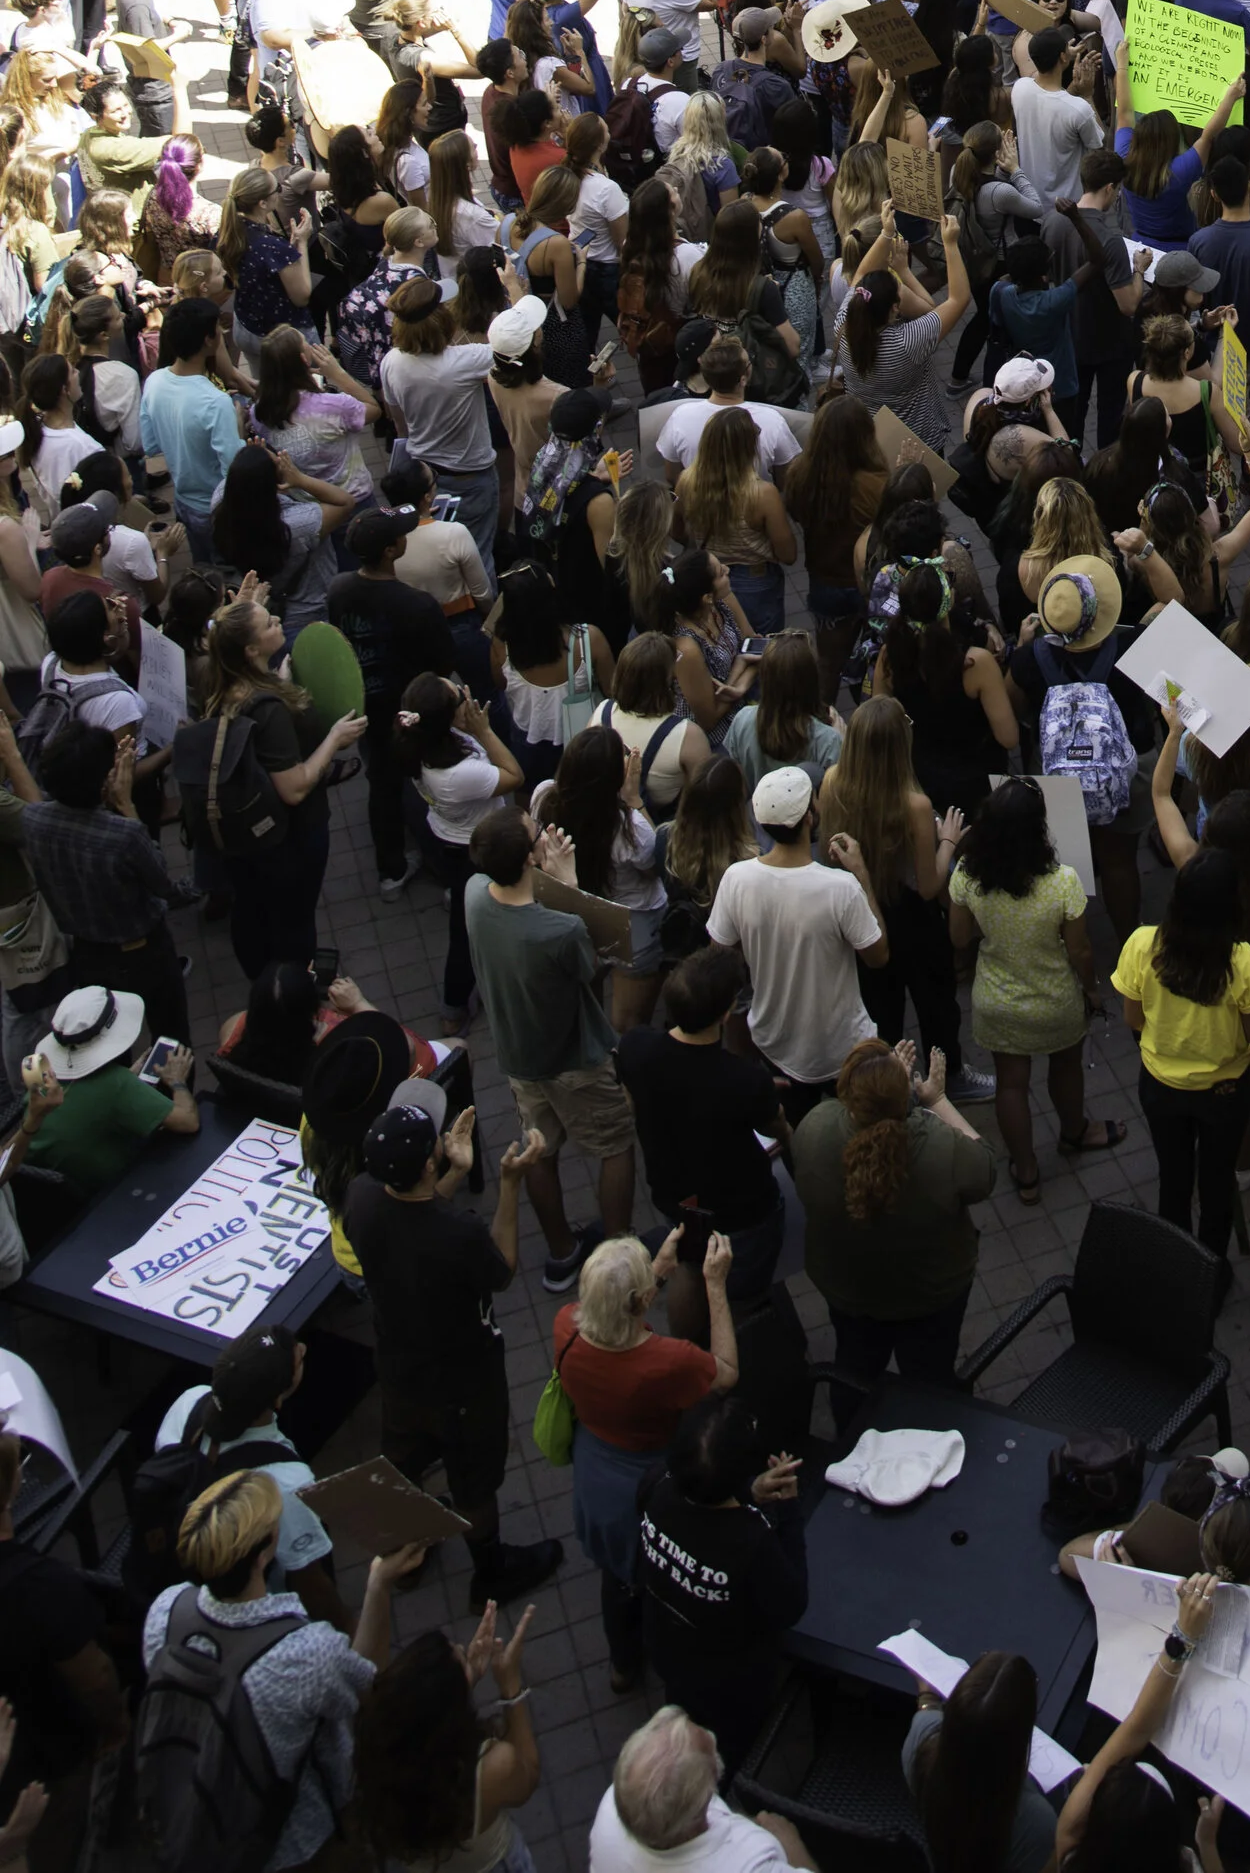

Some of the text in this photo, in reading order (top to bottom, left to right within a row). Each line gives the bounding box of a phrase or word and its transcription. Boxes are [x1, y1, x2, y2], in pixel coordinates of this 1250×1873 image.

[1133, 13, 1147, 27] IN
[1148, 16, 1169, 32] THE
[1161, 6, 1180, 21] ARE
[1186, 11, 1221, 33] RIGHT
[1222, 24, 1242, 41] NOW
[1134, 27, 1146, 36] OF
[1149, 31, 1156, 39] A
[1200, 47, 1221, 61] AND
[1134, 38, 1185, 60] ECOLOGICAL
[1132, 70, 1150, 84] AN
[1157, 67, 1170, 77] IT
[1160, 57, 1176, 68] WE
[1179, 63, 1207, 78] NEED
[1206, 71, 1218, 81] TO
[890, 156, 901, 174] NO
[903, 154, 914, 180] WAIT
[911, 146, 924, 174] YEARS
[904, 179, 914, 192] TO
[130, 1215, 248, 1285] Bernie
[658, 1531, 698, 1575] TIME
[700, 1564, 729, 1586] TO
